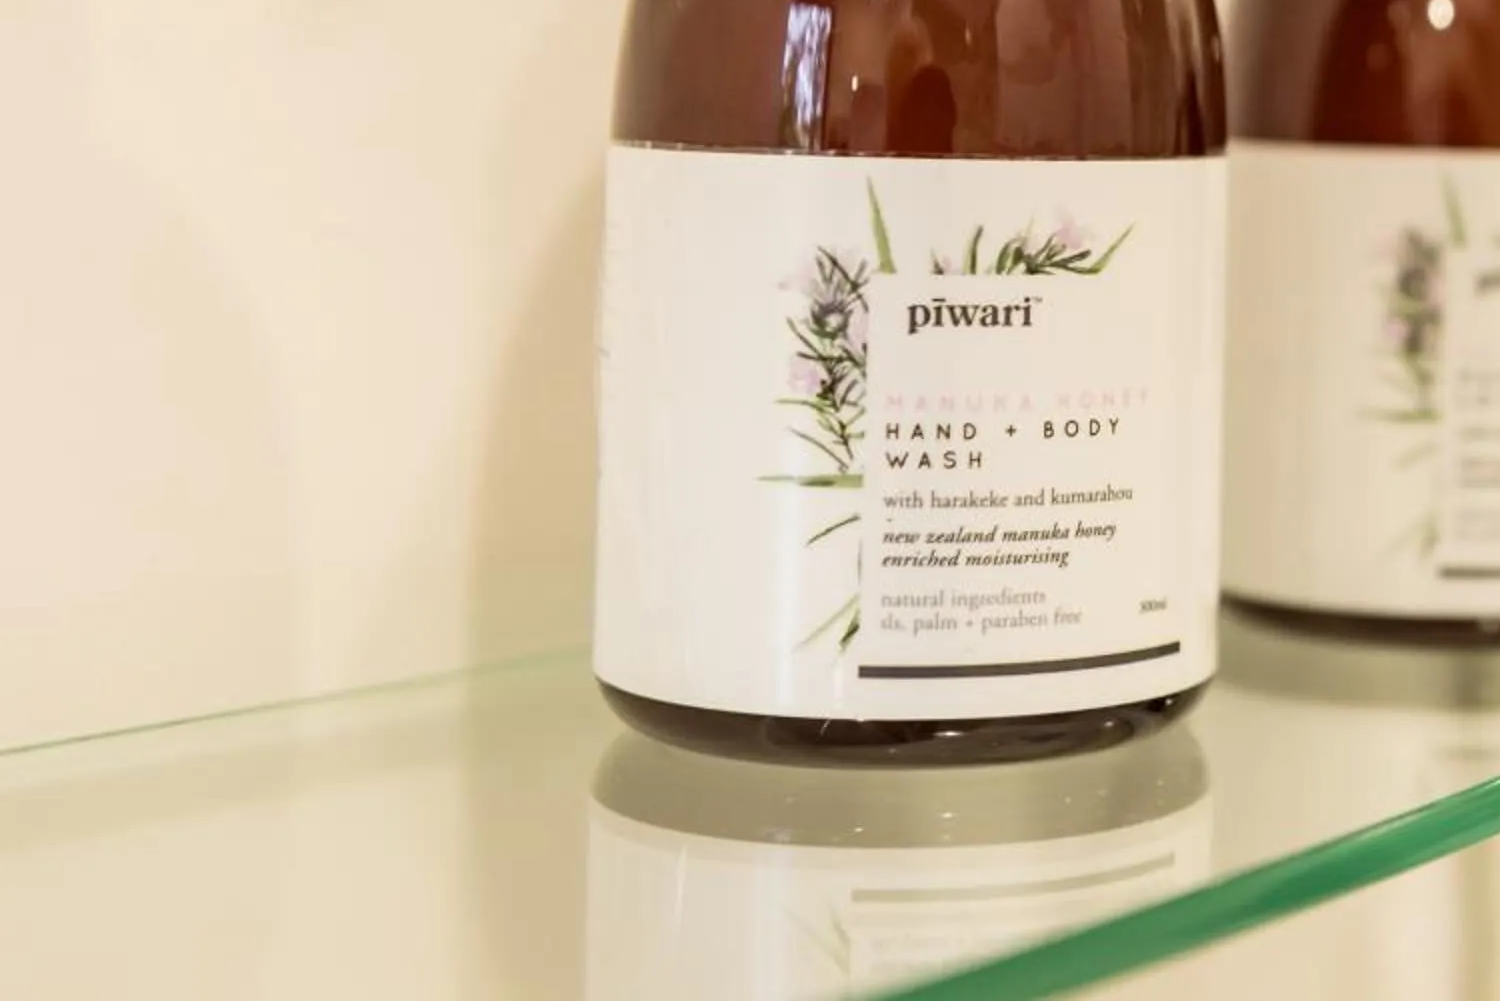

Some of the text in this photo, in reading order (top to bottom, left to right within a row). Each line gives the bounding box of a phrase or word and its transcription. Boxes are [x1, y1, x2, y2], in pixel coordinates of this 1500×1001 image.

[886, 422, 977, 440] HAND
[1043, 418, 1119, 439] BODY
[886, 451, 982, 469] WASH
[884, 484, 1134, 509] with harakeke and kumarahou
[882, 519, 1118, 544] new zealand manuka honey
[881, 547, 1070, 568] enriched moisturising
[881, 588, 1047, 611] natural ingredients
[913, 611, 958, 637] palm
[981, 610, 1049, 636] paraben
[1053, 606, 1083, 625] free
